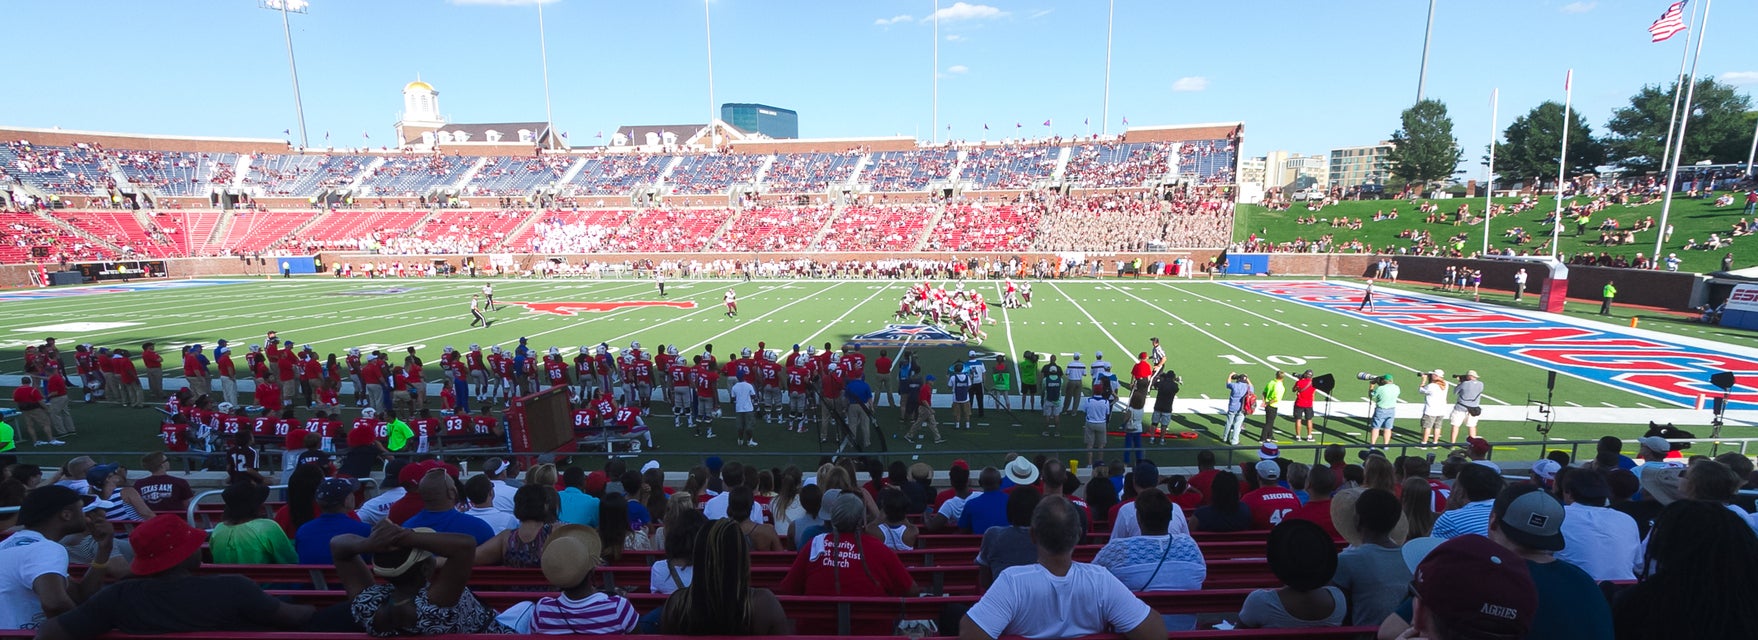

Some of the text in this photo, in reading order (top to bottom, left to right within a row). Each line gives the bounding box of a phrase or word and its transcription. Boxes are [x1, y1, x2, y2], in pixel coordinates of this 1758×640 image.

[447, 419, 462, 431] 93
[575, 414, 590, 426] 94
[232, 454, 248, 471] 12
[141, 483, 172, 495] TEXAS A&M
[1480, 602, 1518, 620] AGGIES
